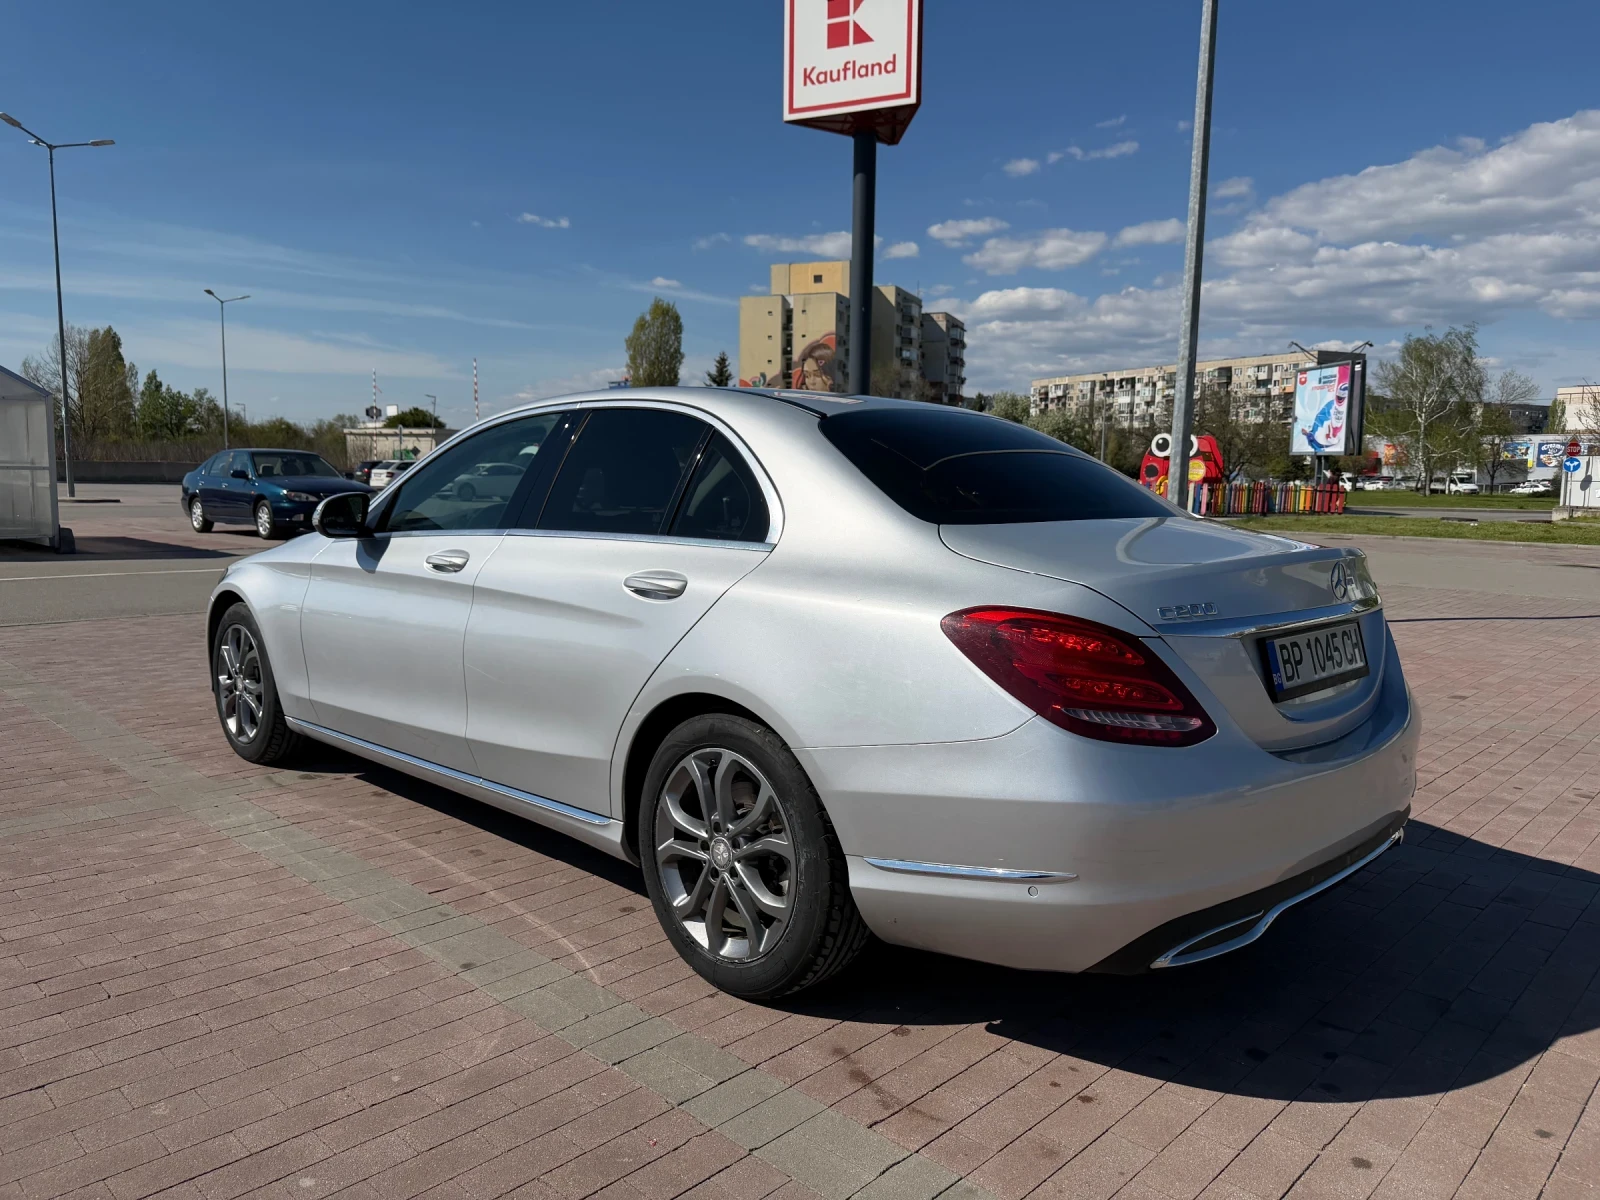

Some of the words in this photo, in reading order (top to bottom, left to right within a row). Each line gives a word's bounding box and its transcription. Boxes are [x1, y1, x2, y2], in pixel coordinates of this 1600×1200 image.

[803, 53, 896, 87] Kaufland
[1278, 641, 1303, 682] BP
[1306, 633, 1343, 675] 1045
[1341, 628, 1363, 665] CH
[1272, 672, 1282, 685] BG
